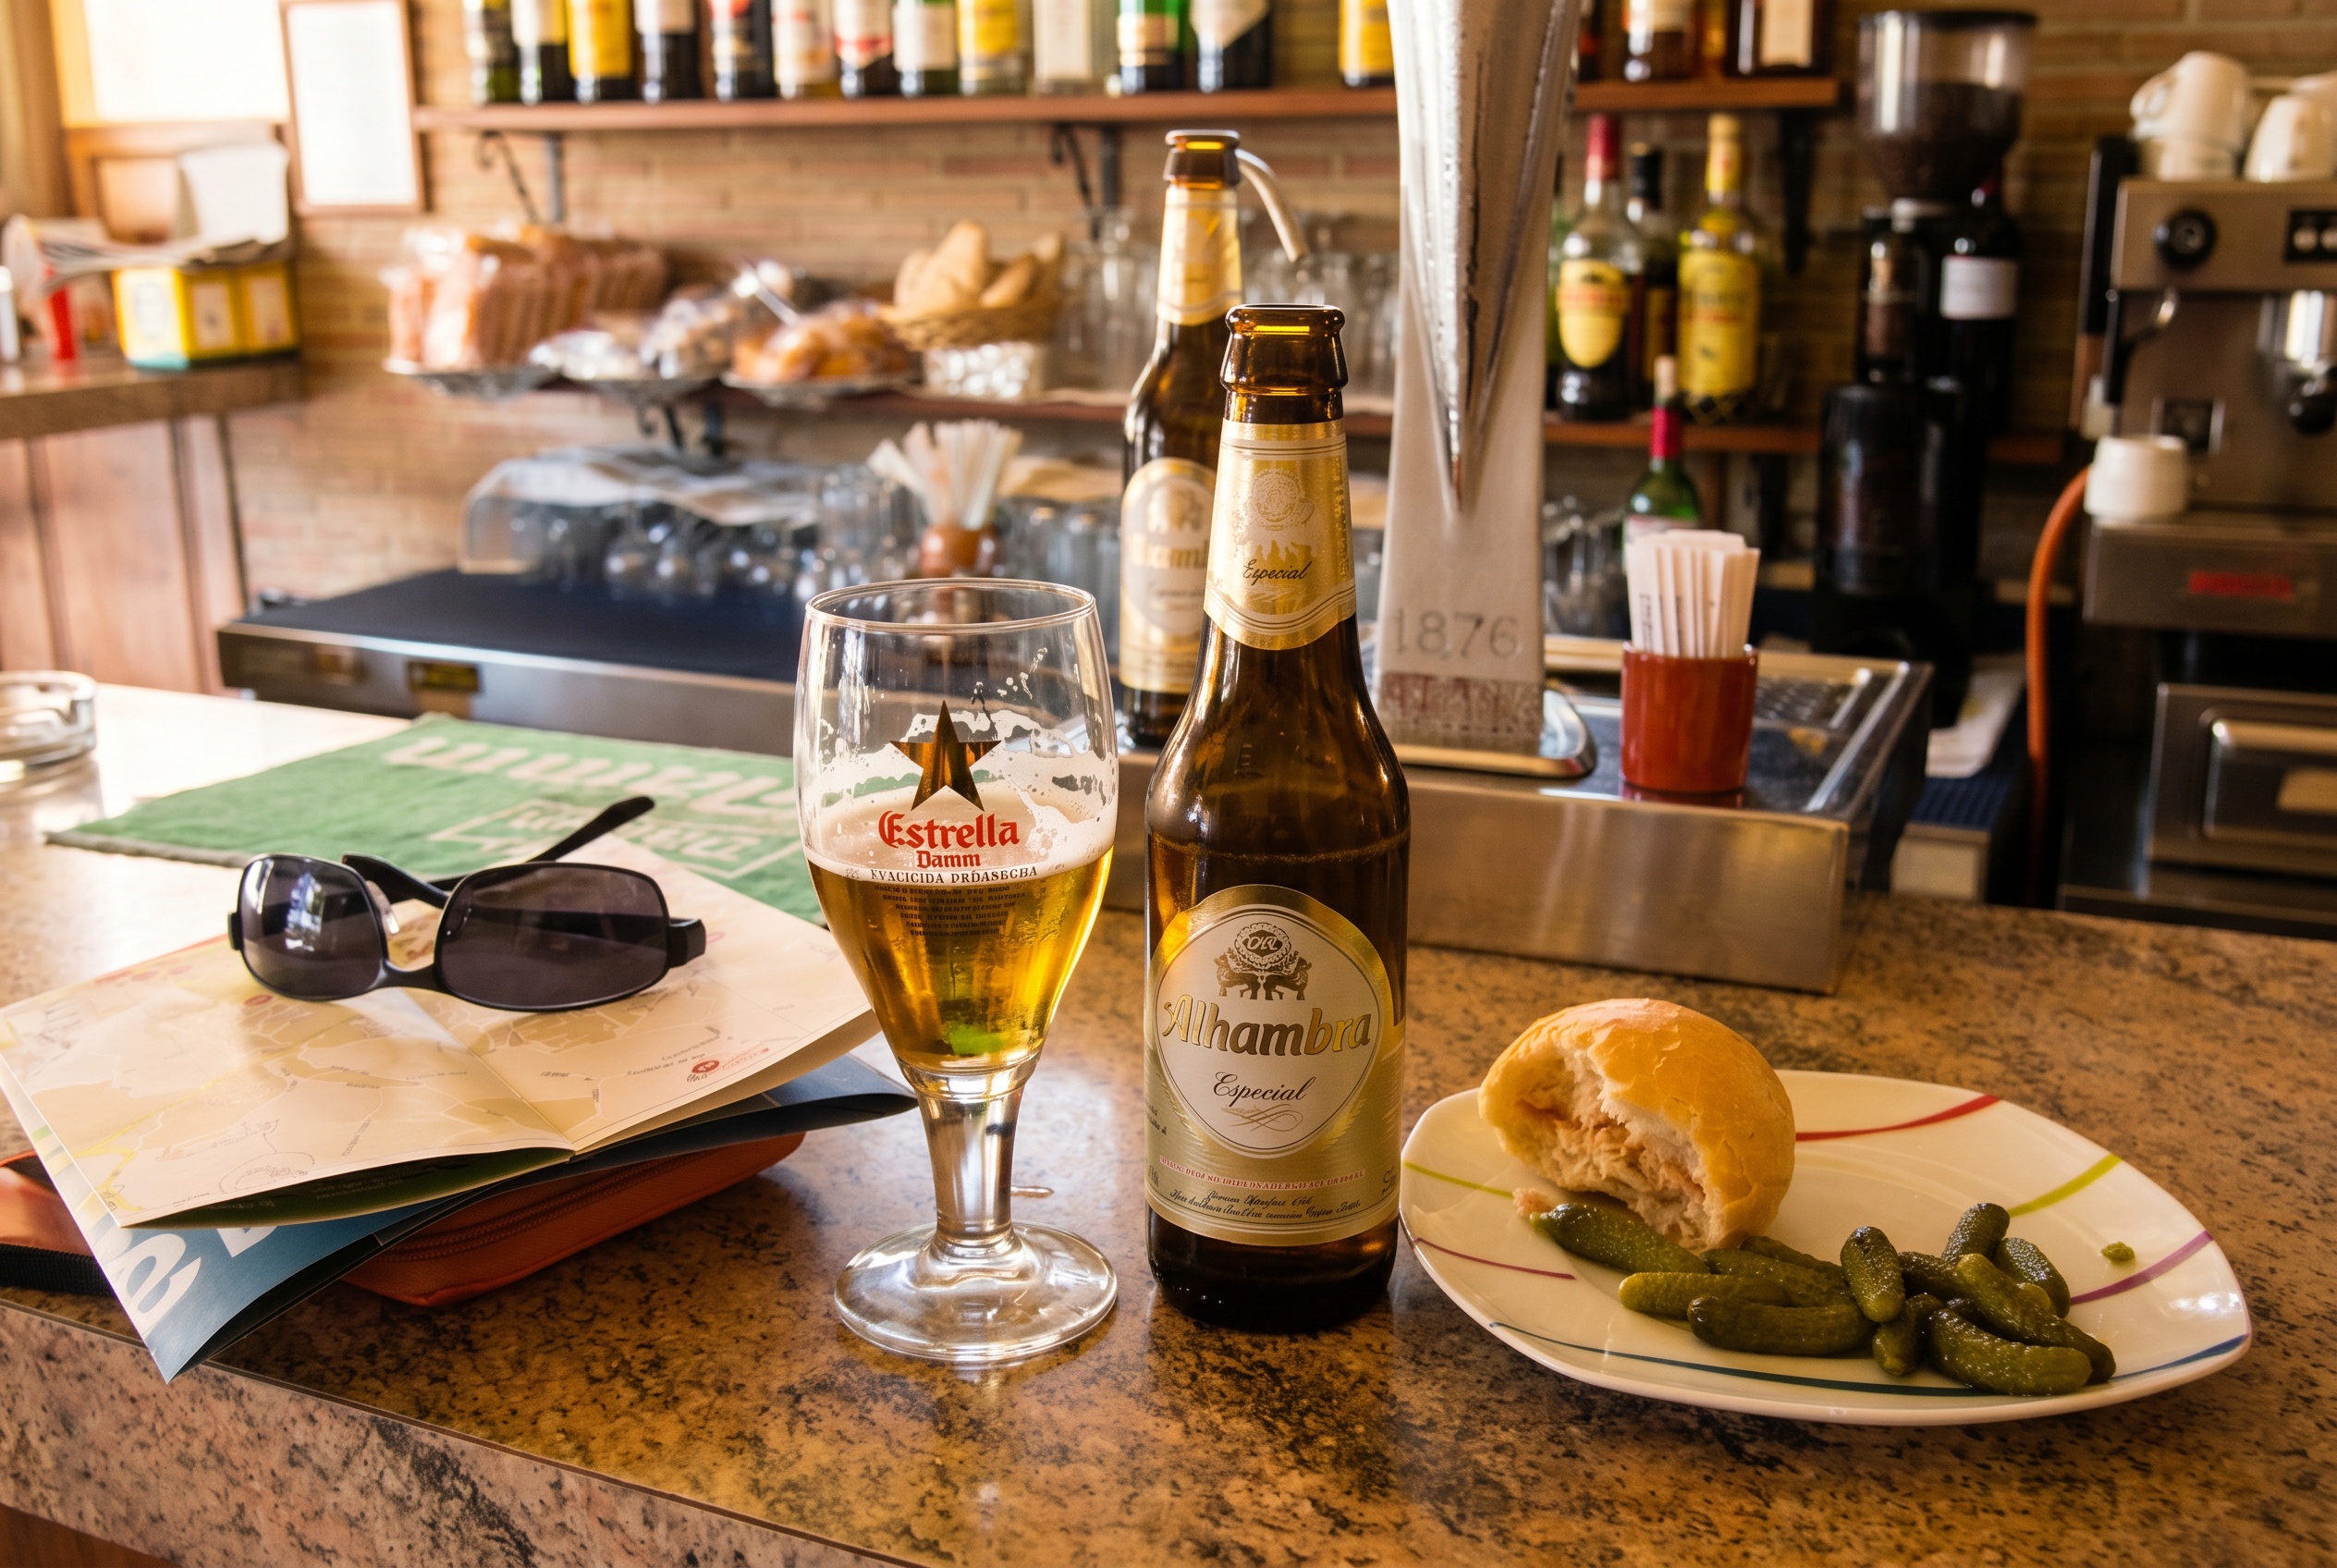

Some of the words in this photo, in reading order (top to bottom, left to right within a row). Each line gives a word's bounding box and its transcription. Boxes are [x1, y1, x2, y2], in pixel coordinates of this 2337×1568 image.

[1242, 559, 1313, 586] Especial
[878, 810, 1020, 849] Estrella
[916, 850, 982, 869] Damm
[1162, 994, 1372, 1056] Alhambra
[1213, 1071, 1316, 1108] Especial
